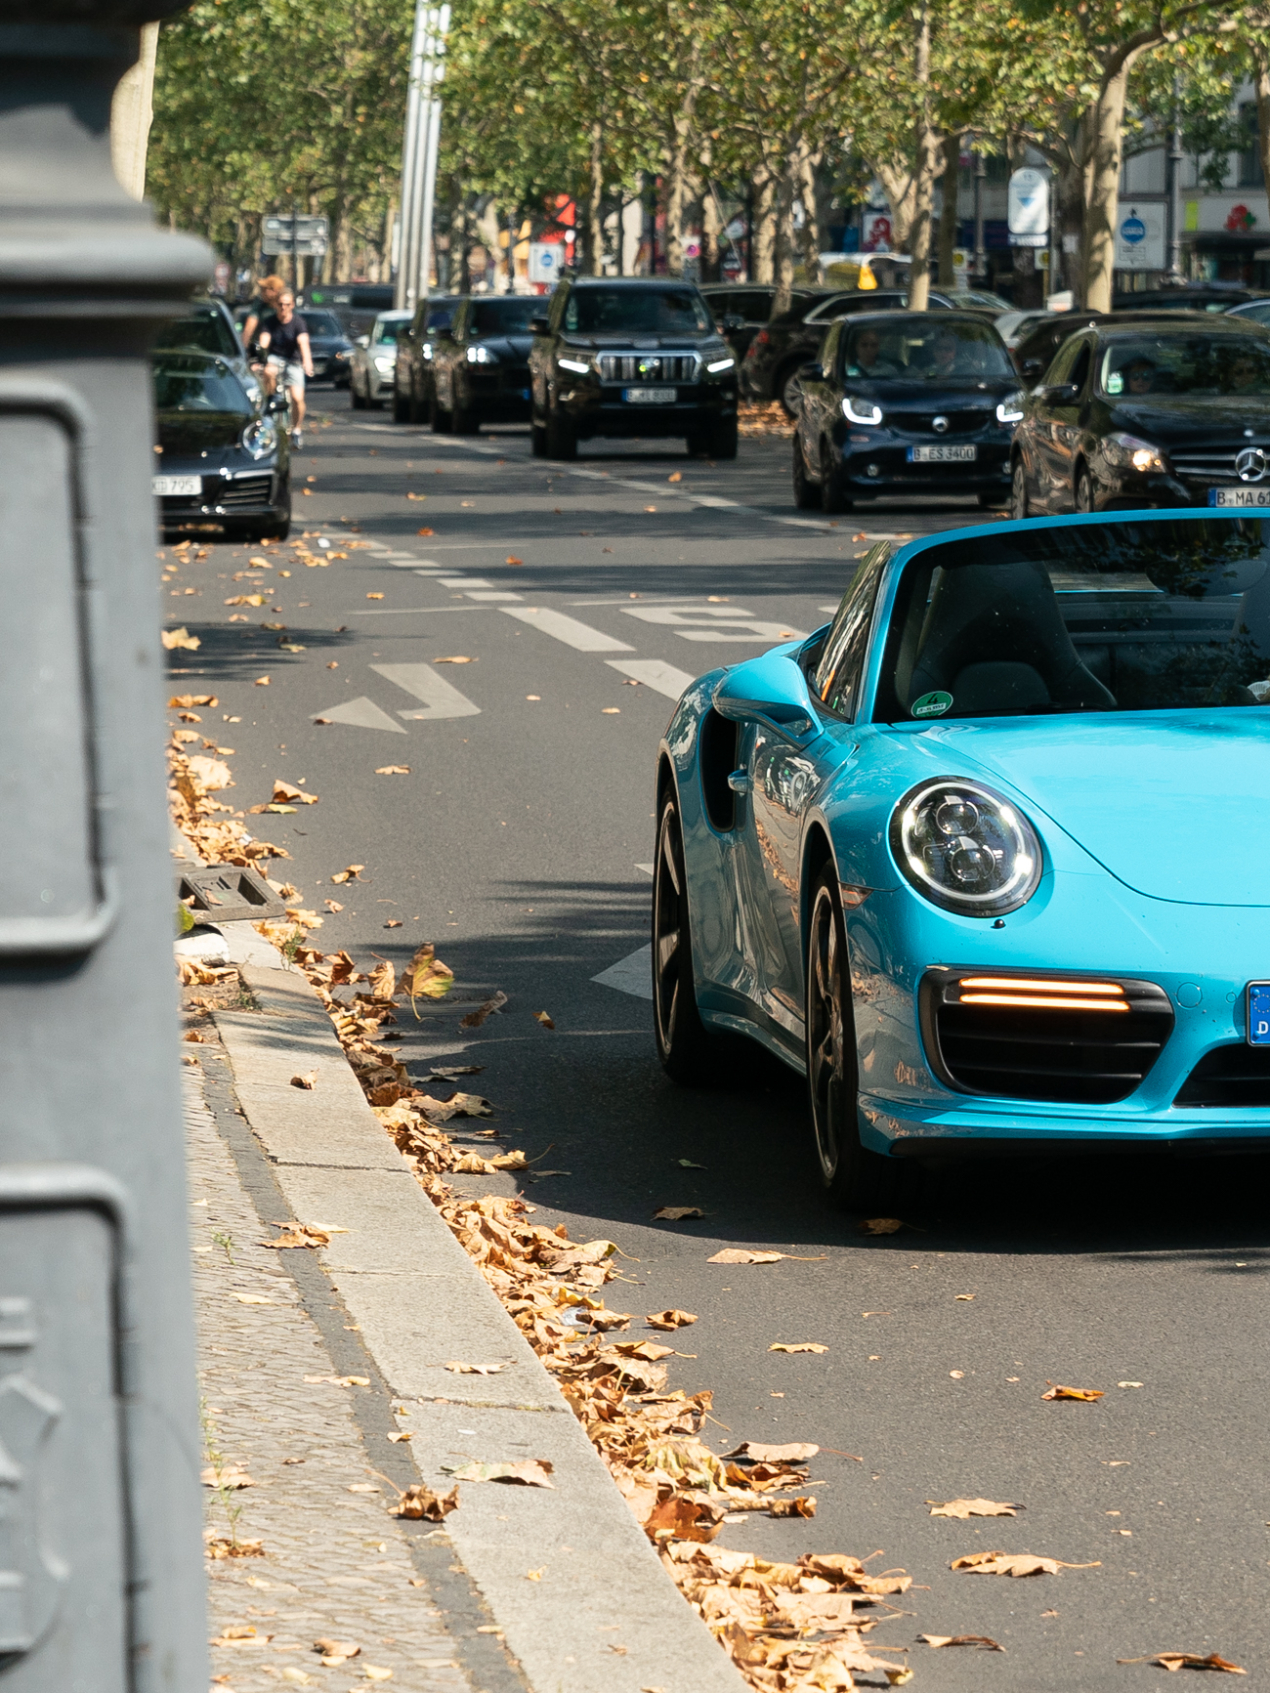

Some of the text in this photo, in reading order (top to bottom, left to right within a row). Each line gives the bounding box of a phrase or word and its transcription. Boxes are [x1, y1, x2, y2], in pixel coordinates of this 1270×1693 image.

[929, 448, 943, 460] ES
[946, 448, 973, 460] 3400
[1217, 492, 1226, 505] B
[1236, 492, 1254, 505] MA
[927, 693, 938, 704] 4
[1257, 1021, 1269, 1035] D
